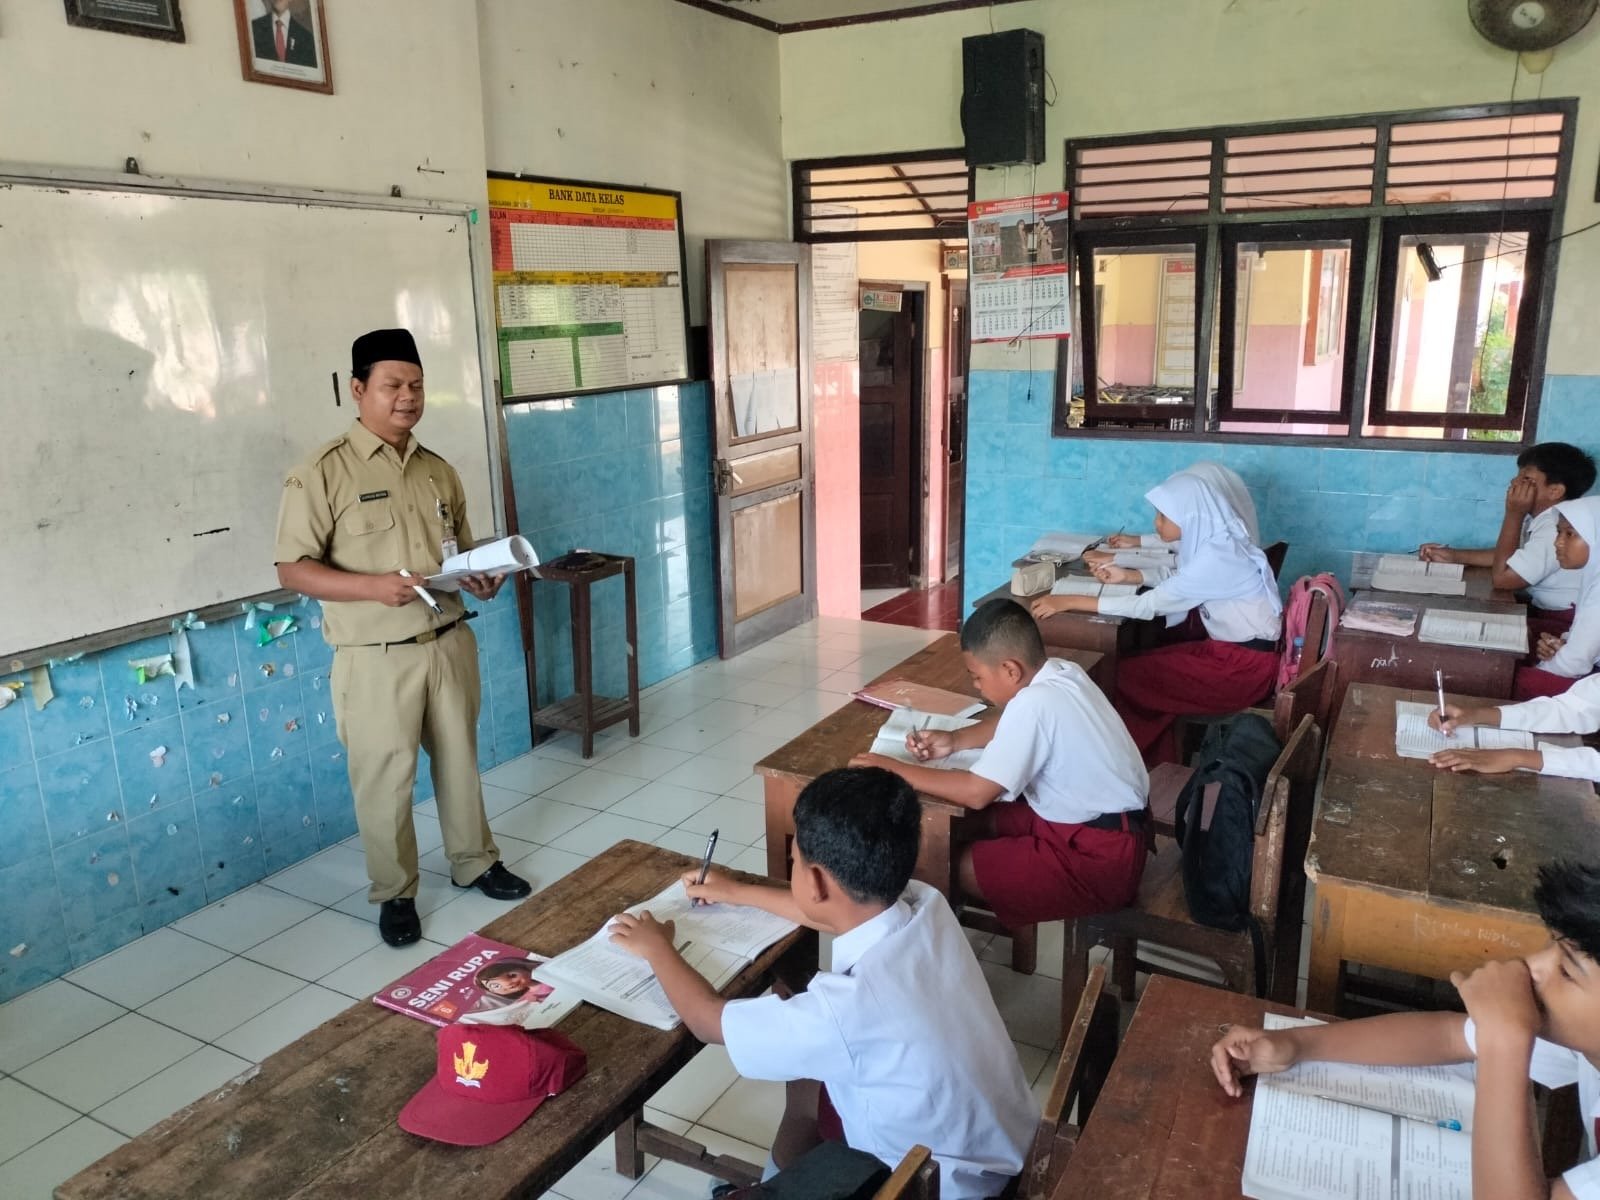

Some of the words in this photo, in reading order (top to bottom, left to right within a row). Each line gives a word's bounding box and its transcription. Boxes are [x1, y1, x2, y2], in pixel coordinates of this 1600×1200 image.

[549, 188, 574, 201] BANK
[575, 191, 597, 203] DATA
[599, 193, 624, 205] KELAS
[408, 979, 455, 1009] SENI
[447, 948, 501, 981] RUPA
